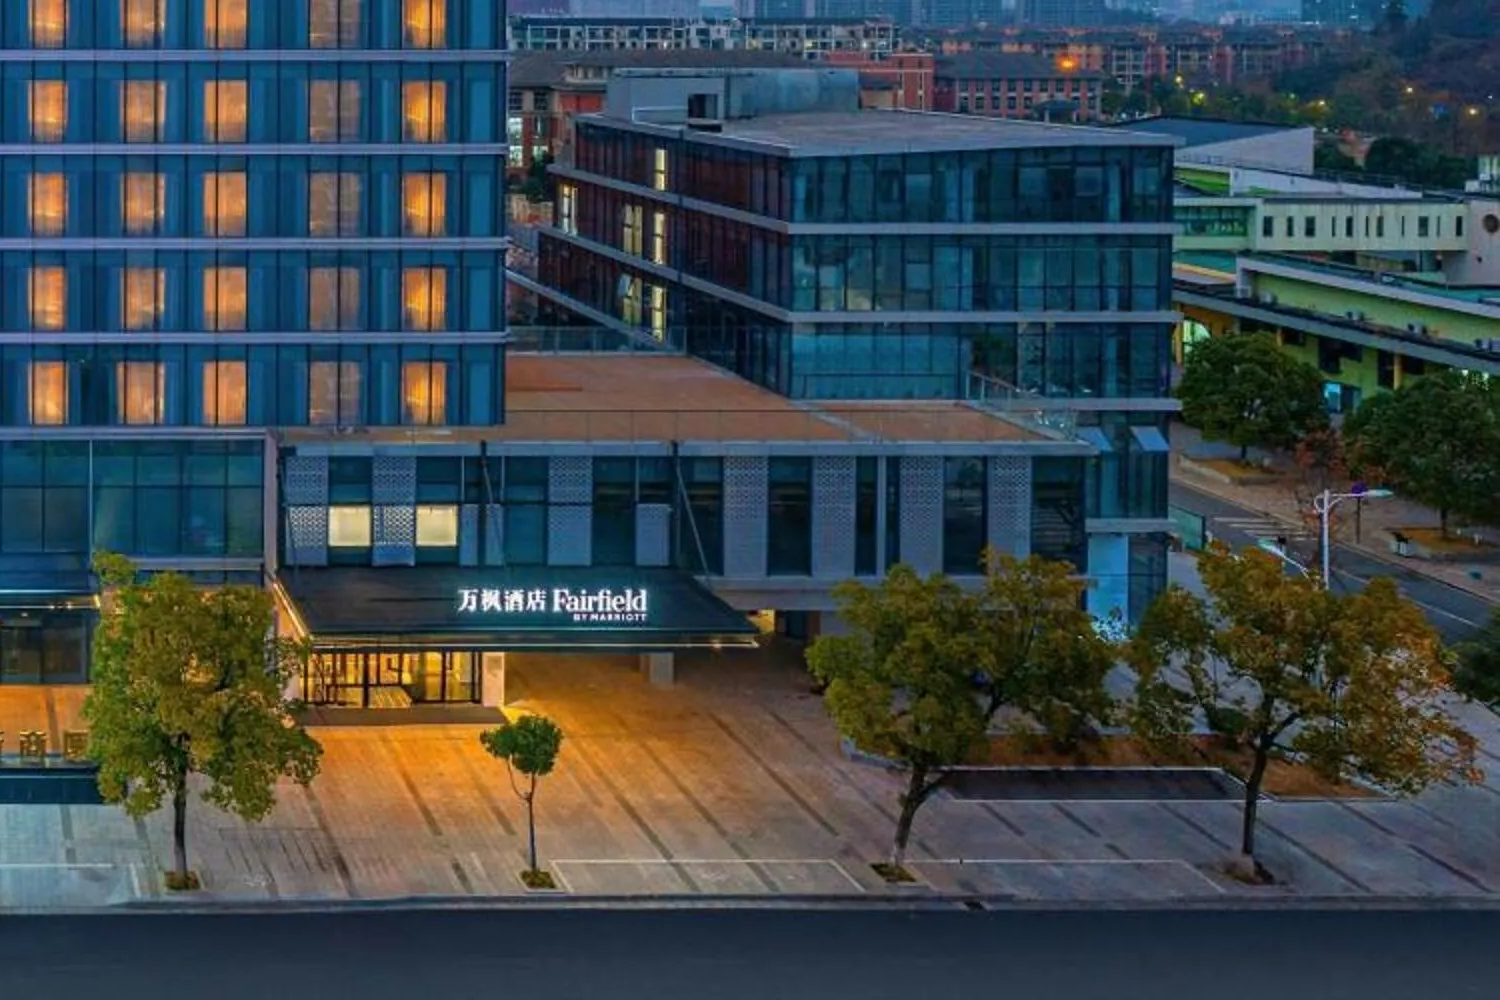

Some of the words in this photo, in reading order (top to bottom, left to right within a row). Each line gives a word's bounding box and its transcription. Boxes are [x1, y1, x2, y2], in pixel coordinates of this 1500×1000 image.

[458, 588, 546, 612] 万枫酒店
[553, 588, 647, 613] Fairfield
[590, 613, 647, 621] MARRIOTT
